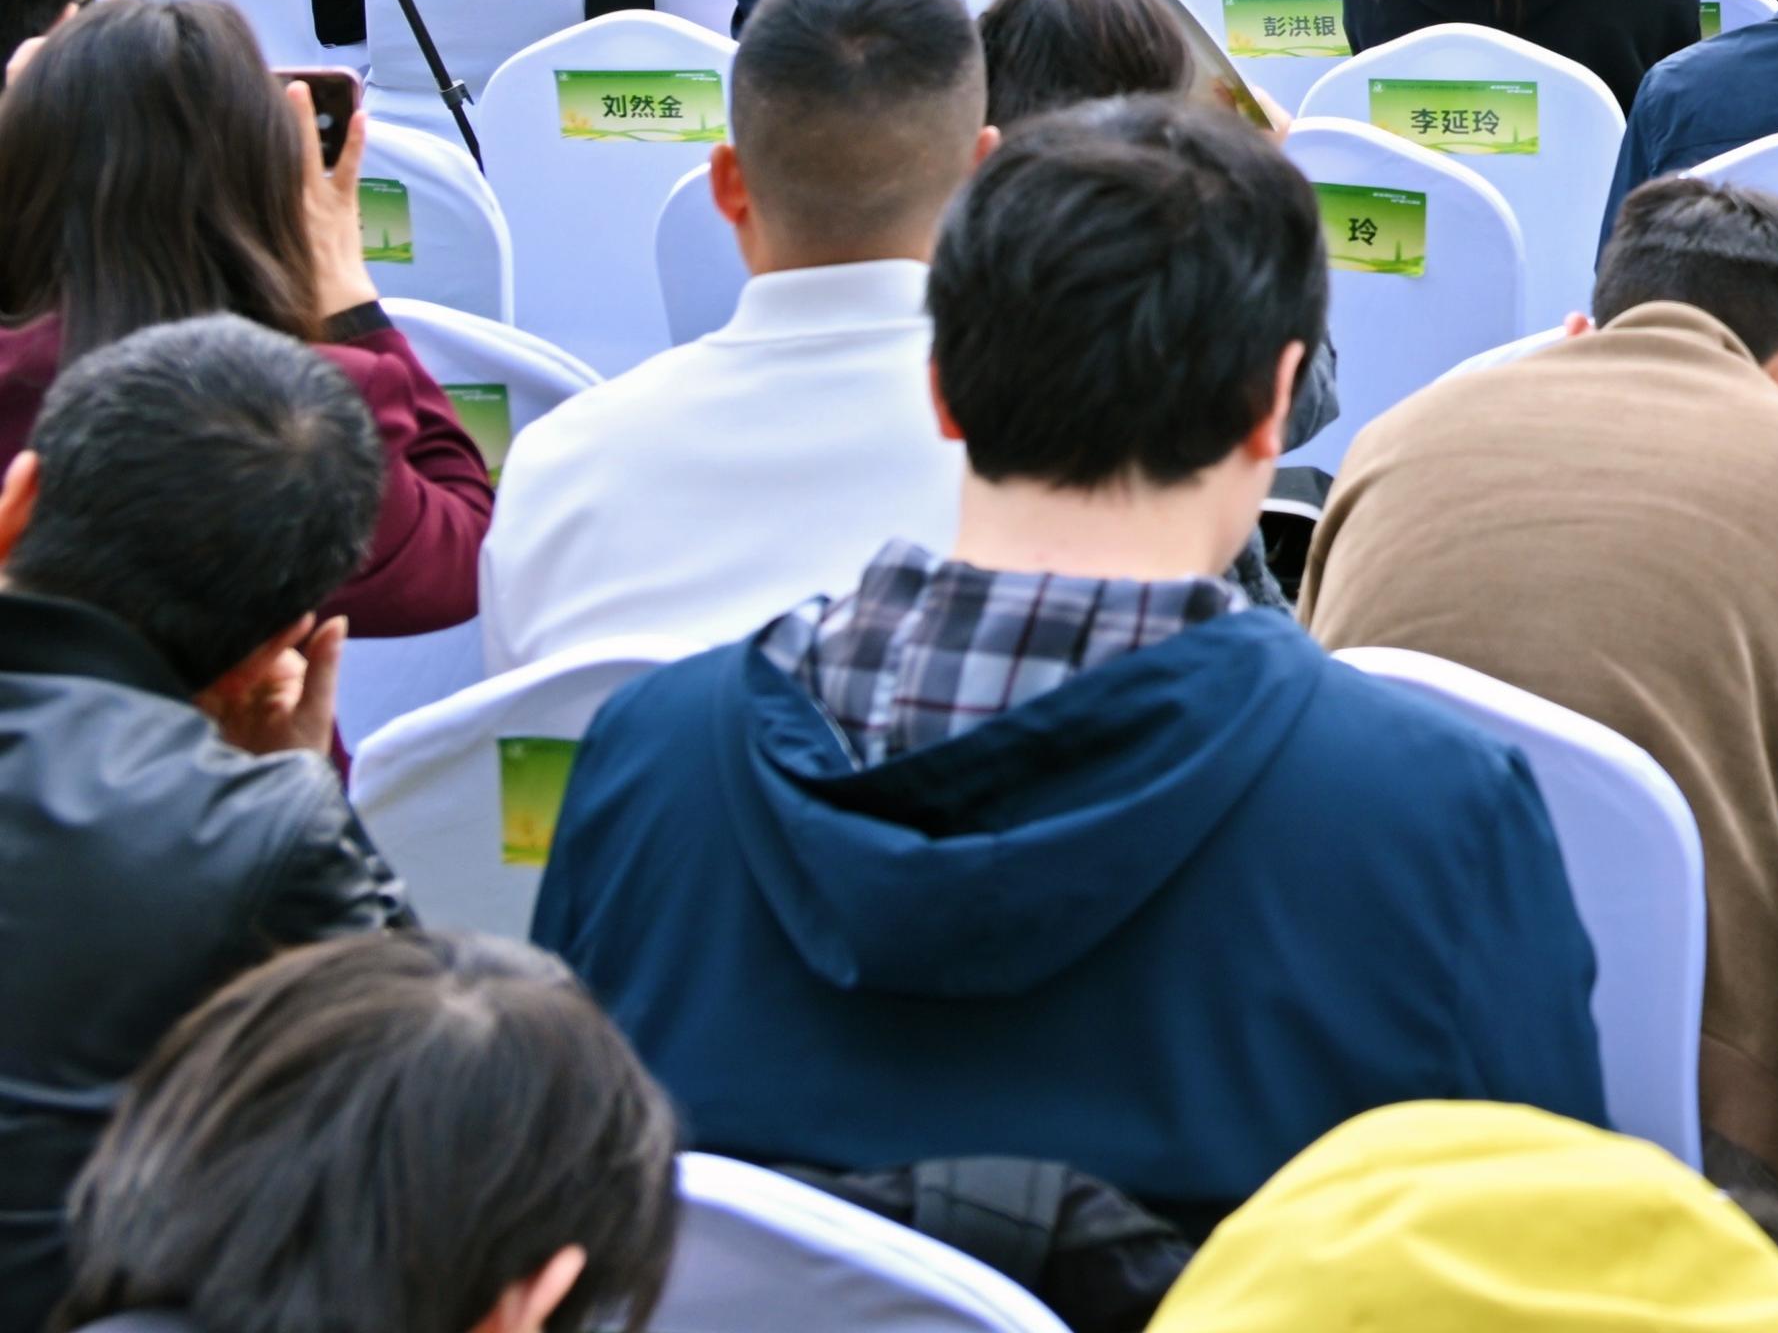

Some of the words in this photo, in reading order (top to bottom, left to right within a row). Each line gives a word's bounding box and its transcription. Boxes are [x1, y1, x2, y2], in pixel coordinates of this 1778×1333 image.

[1263, 15, 1336, 39] 彭洪银
[601, 93, 684, 121] 刘然金
[1410, 108, 1500, 135] 李延玲
[1348, 216, 1379, 248] 玲
